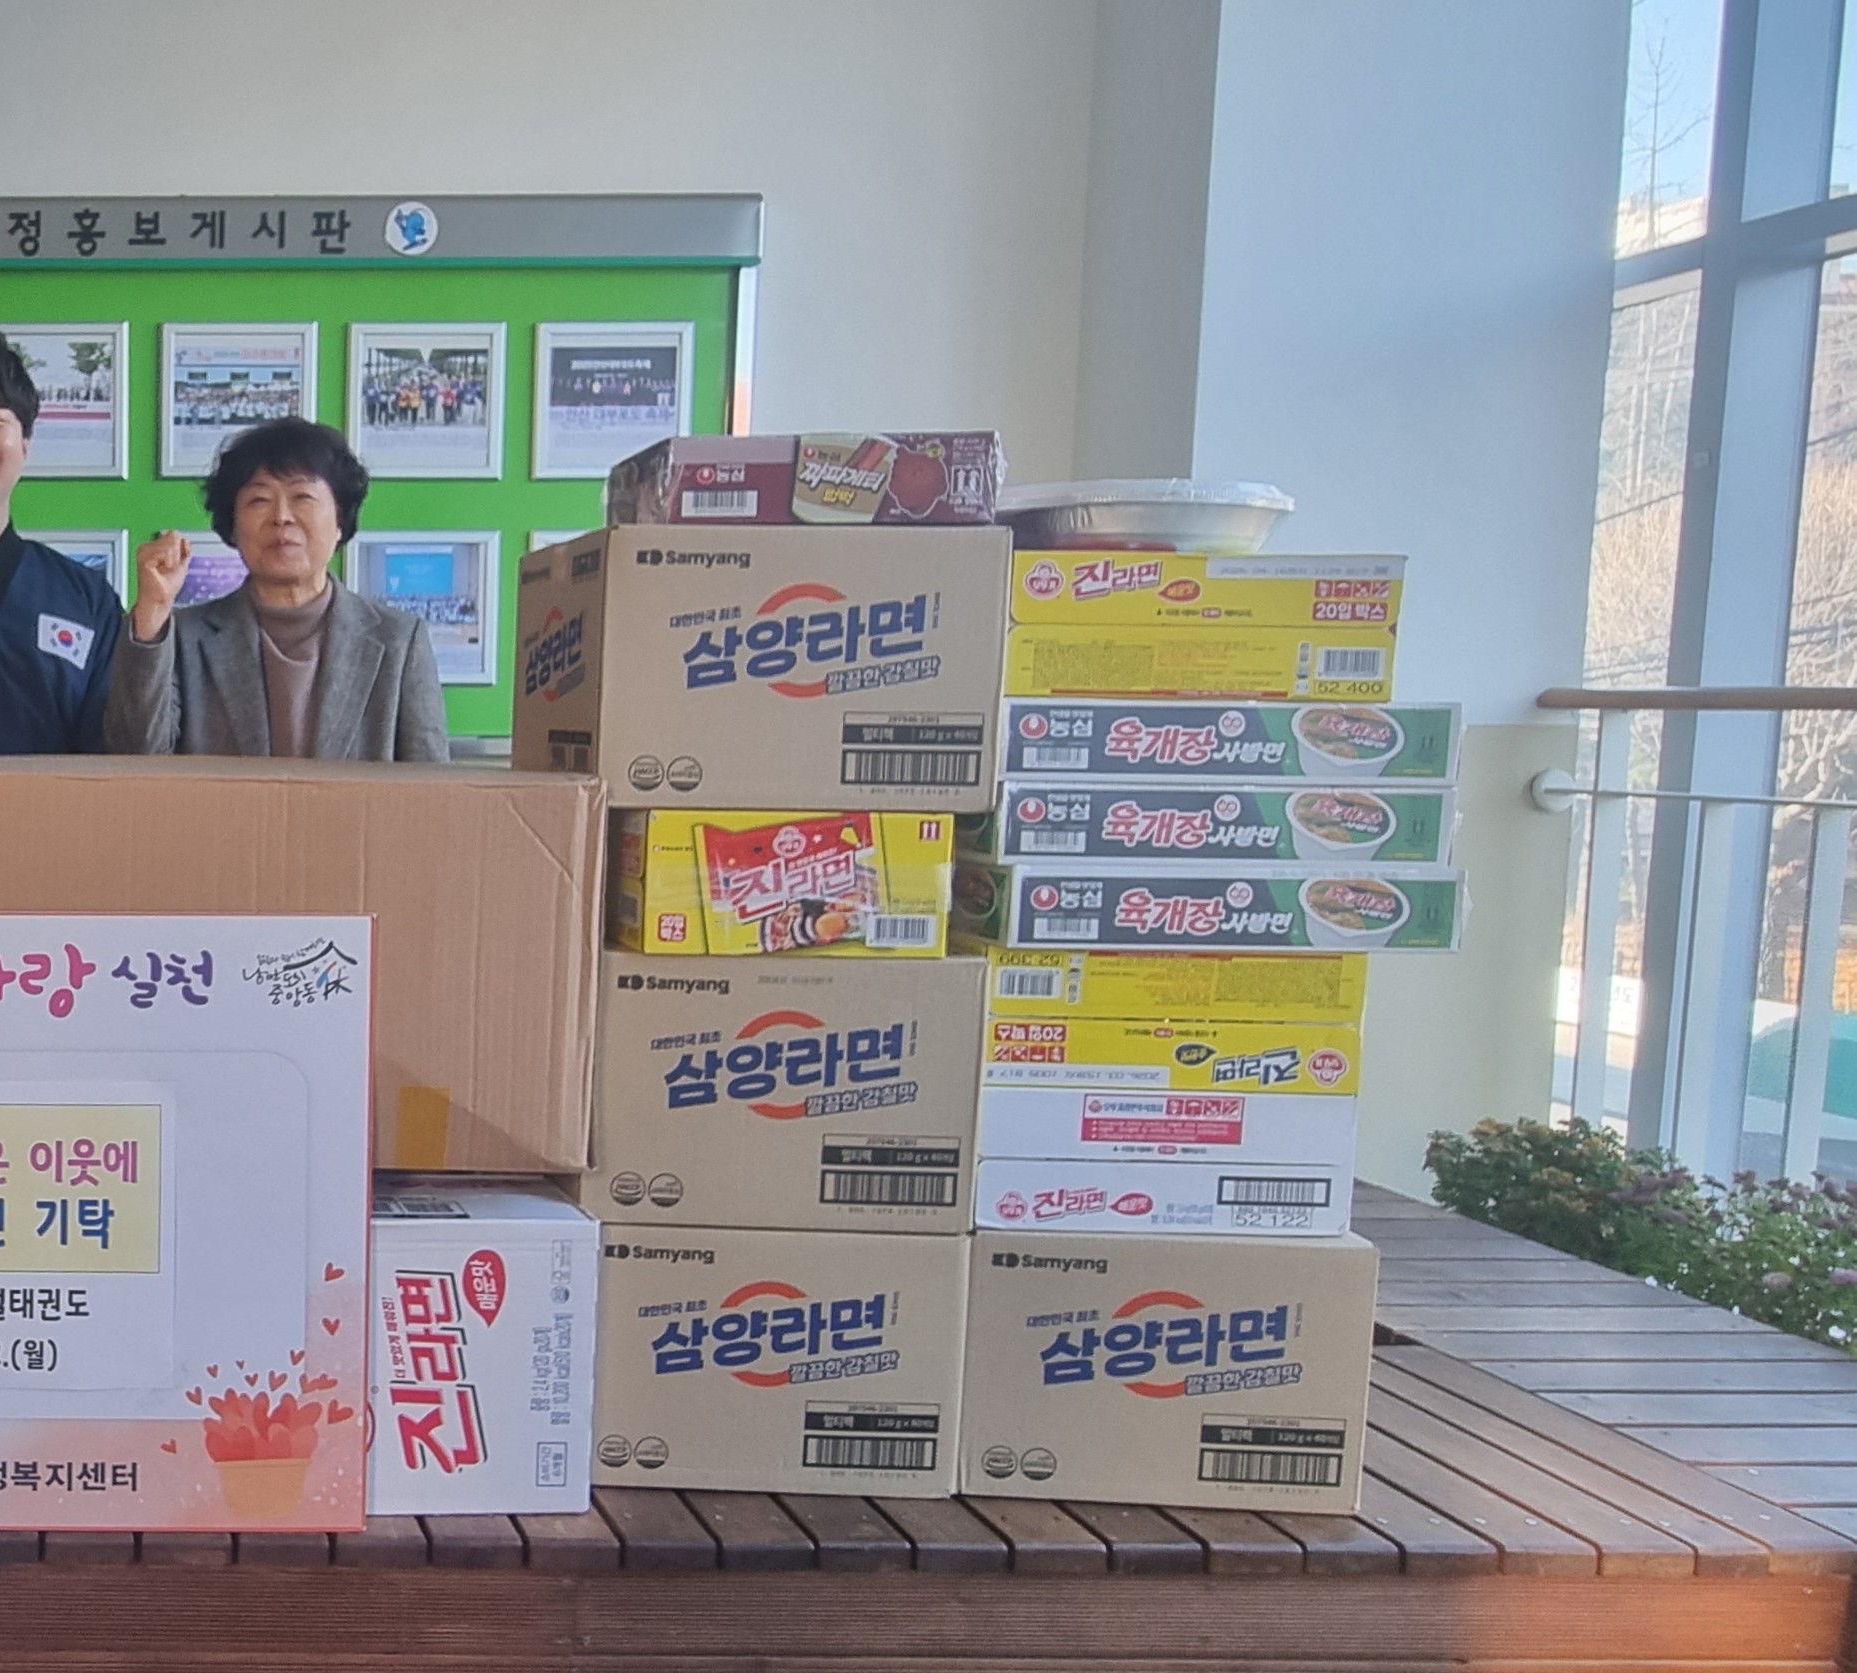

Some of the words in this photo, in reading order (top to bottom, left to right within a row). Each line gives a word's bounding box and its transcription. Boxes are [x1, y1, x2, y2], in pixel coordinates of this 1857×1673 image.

[798, 461, 887, 493] 짜파게티
[665, 550, 751, 569] Samyang
[1070, 558, 1163, 600] 진라면
[669, 610, 717, 628] 대한민국
[1314, 602, 1353, 621] 20입
[1354, 602, 1388, 621] 박스
[525, 612, 584, 697] 삼양라면
[683, 594, 927, 690] 삼양라면
[826, 668, 883, 695] 깔끔한
[883, 656, 941, 684] 감칠맛
[1318, 681, 1342, 695] 52
[1346, 681, 1384, 695] 400
[1049, 718, 1094, 738] 농심
[1104, 716, 1218, 764] 육개장
[1213, 740, 1287, 765] 사발면
[1046, 801, 1091, 821] 농심
[1101, 800, 1212, 849] 육개장
[1207, 824, 1279, 848] 사발면
[731, 853, 857, 925] 진라면
[1058, 887, 1103, 909] 농심
[1114, 887, 1224, 936] 육개장
[1220, 910, 1293, 935] 사발면
[111, 949, 213, 1009] 실천
[266, 984, 318, 1008] 중앙동
[646, 976, 730, 994] Samyang
[650, 1033, 697, 1050] 대한민국
[997, 1025, 1026, 1040] 박스
[1029, 1025, 1064, 1041] 20입
[664, 1022, 904, 1110] 삼양라면
[1209, 1045, 1302, 1087] 진라면
[805, 1093, 860, 1117] 깔끔한
[860, 1081, 919, 1109] 감칠맛
[28, 1137, 140, 1188] 이웃에
[1031, 1187, 1108, 1222] 진라면
[1234, 1214, 1263, 1227] 52
[1270, 1214, 1310, 1227] 122
[35, 1196, 116, 1250] 기탁
[633, 1245, 715, 1264] Samyang
[1022, 1254, 1108, 1274] Samyang
[468, 1259, 499, 1312] 매운맛
[637, 1303, 683, 1318] 대한민국
[1026, 1314, 1074, 1328] 대한민국
[651, 1293, 885, 1375] 삼양라면
[1039, 1305, 1290, 1386] 삼양라면
[389, 1270, 489, 1476] 진라면
[789, 1361, 842, 1384] 깔끔한
[845, 1350, 900, 1377] 감칠맛
[1184, 1374, 1242, 1397] 깔끔한
[1244, 1363, 1303, 1390] 감칠맛
